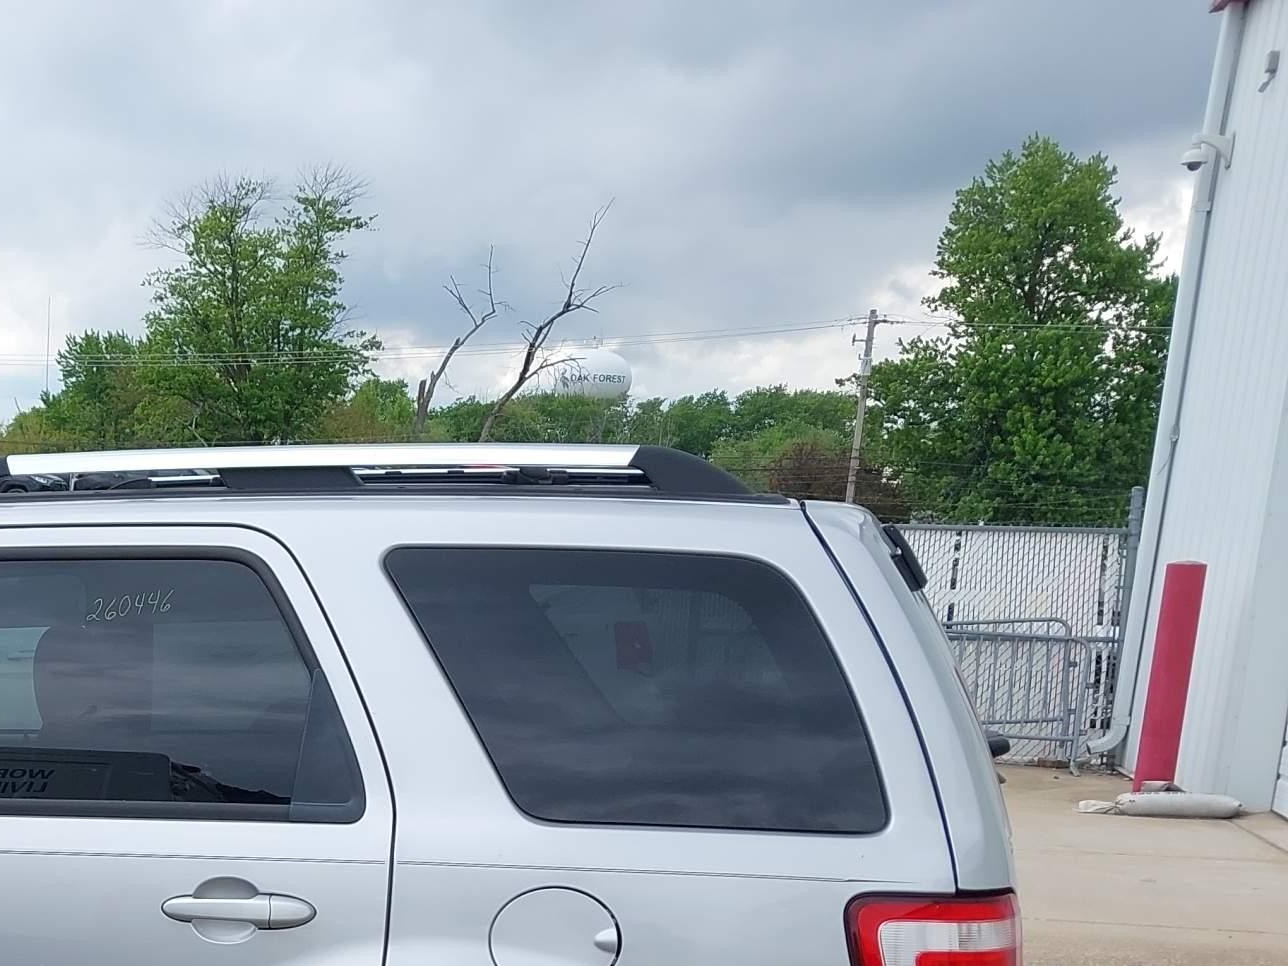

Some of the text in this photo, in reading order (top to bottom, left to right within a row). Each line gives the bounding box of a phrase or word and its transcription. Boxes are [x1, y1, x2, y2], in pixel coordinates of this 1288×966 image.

[570, 373, 626, 384] OAK FOREST
[86, 589, 174, 621] 260446
